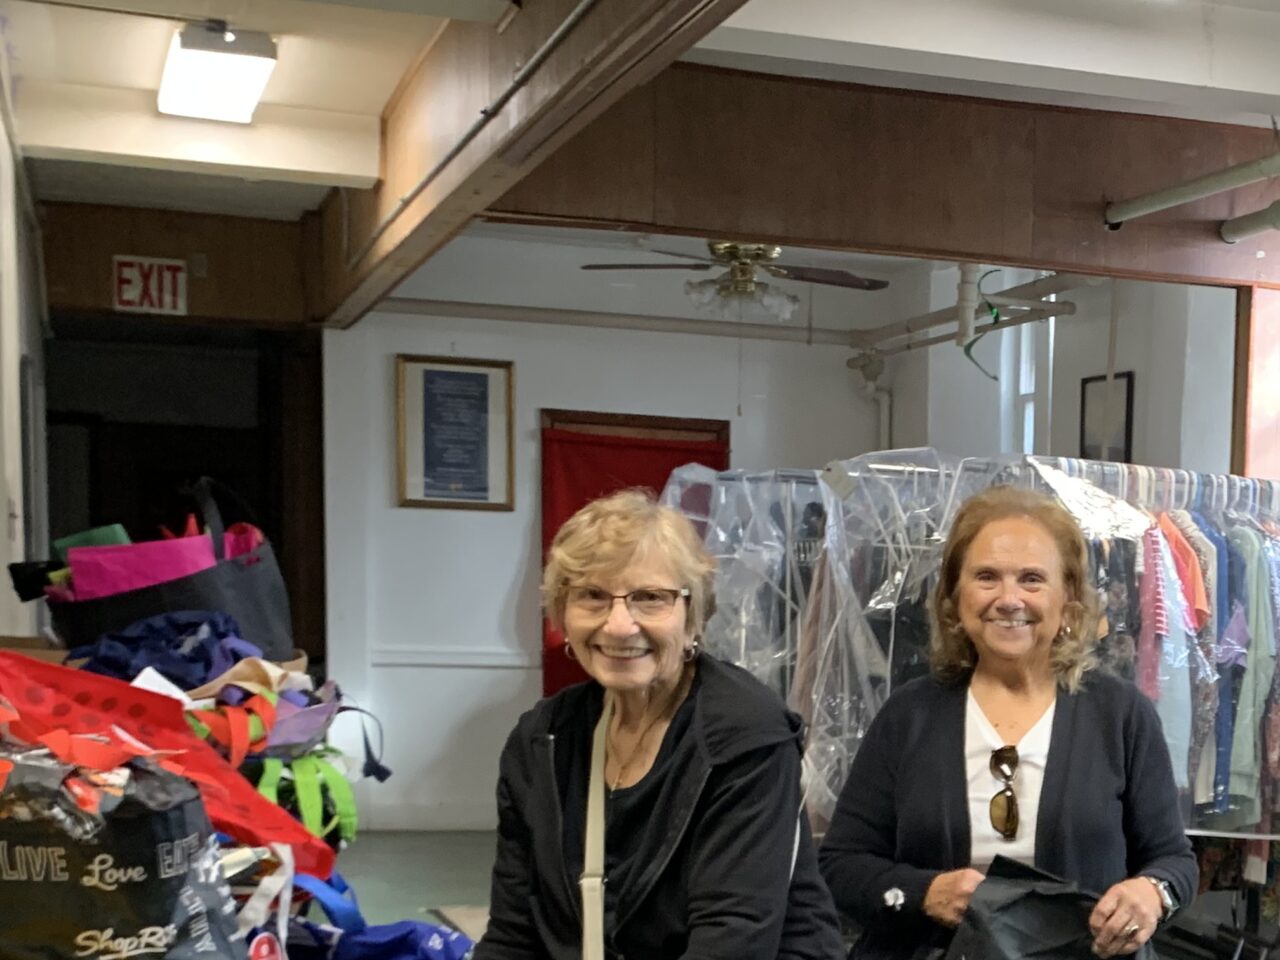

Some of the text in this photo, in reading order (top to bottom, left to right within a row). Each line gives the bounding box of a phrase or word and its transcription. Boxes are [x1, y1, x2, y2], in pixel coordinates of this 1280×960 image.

[117, 261, 184, 310] EXIT
[0, 841, 69, 882] LIVE
[81, 853, 148, 891] Love
